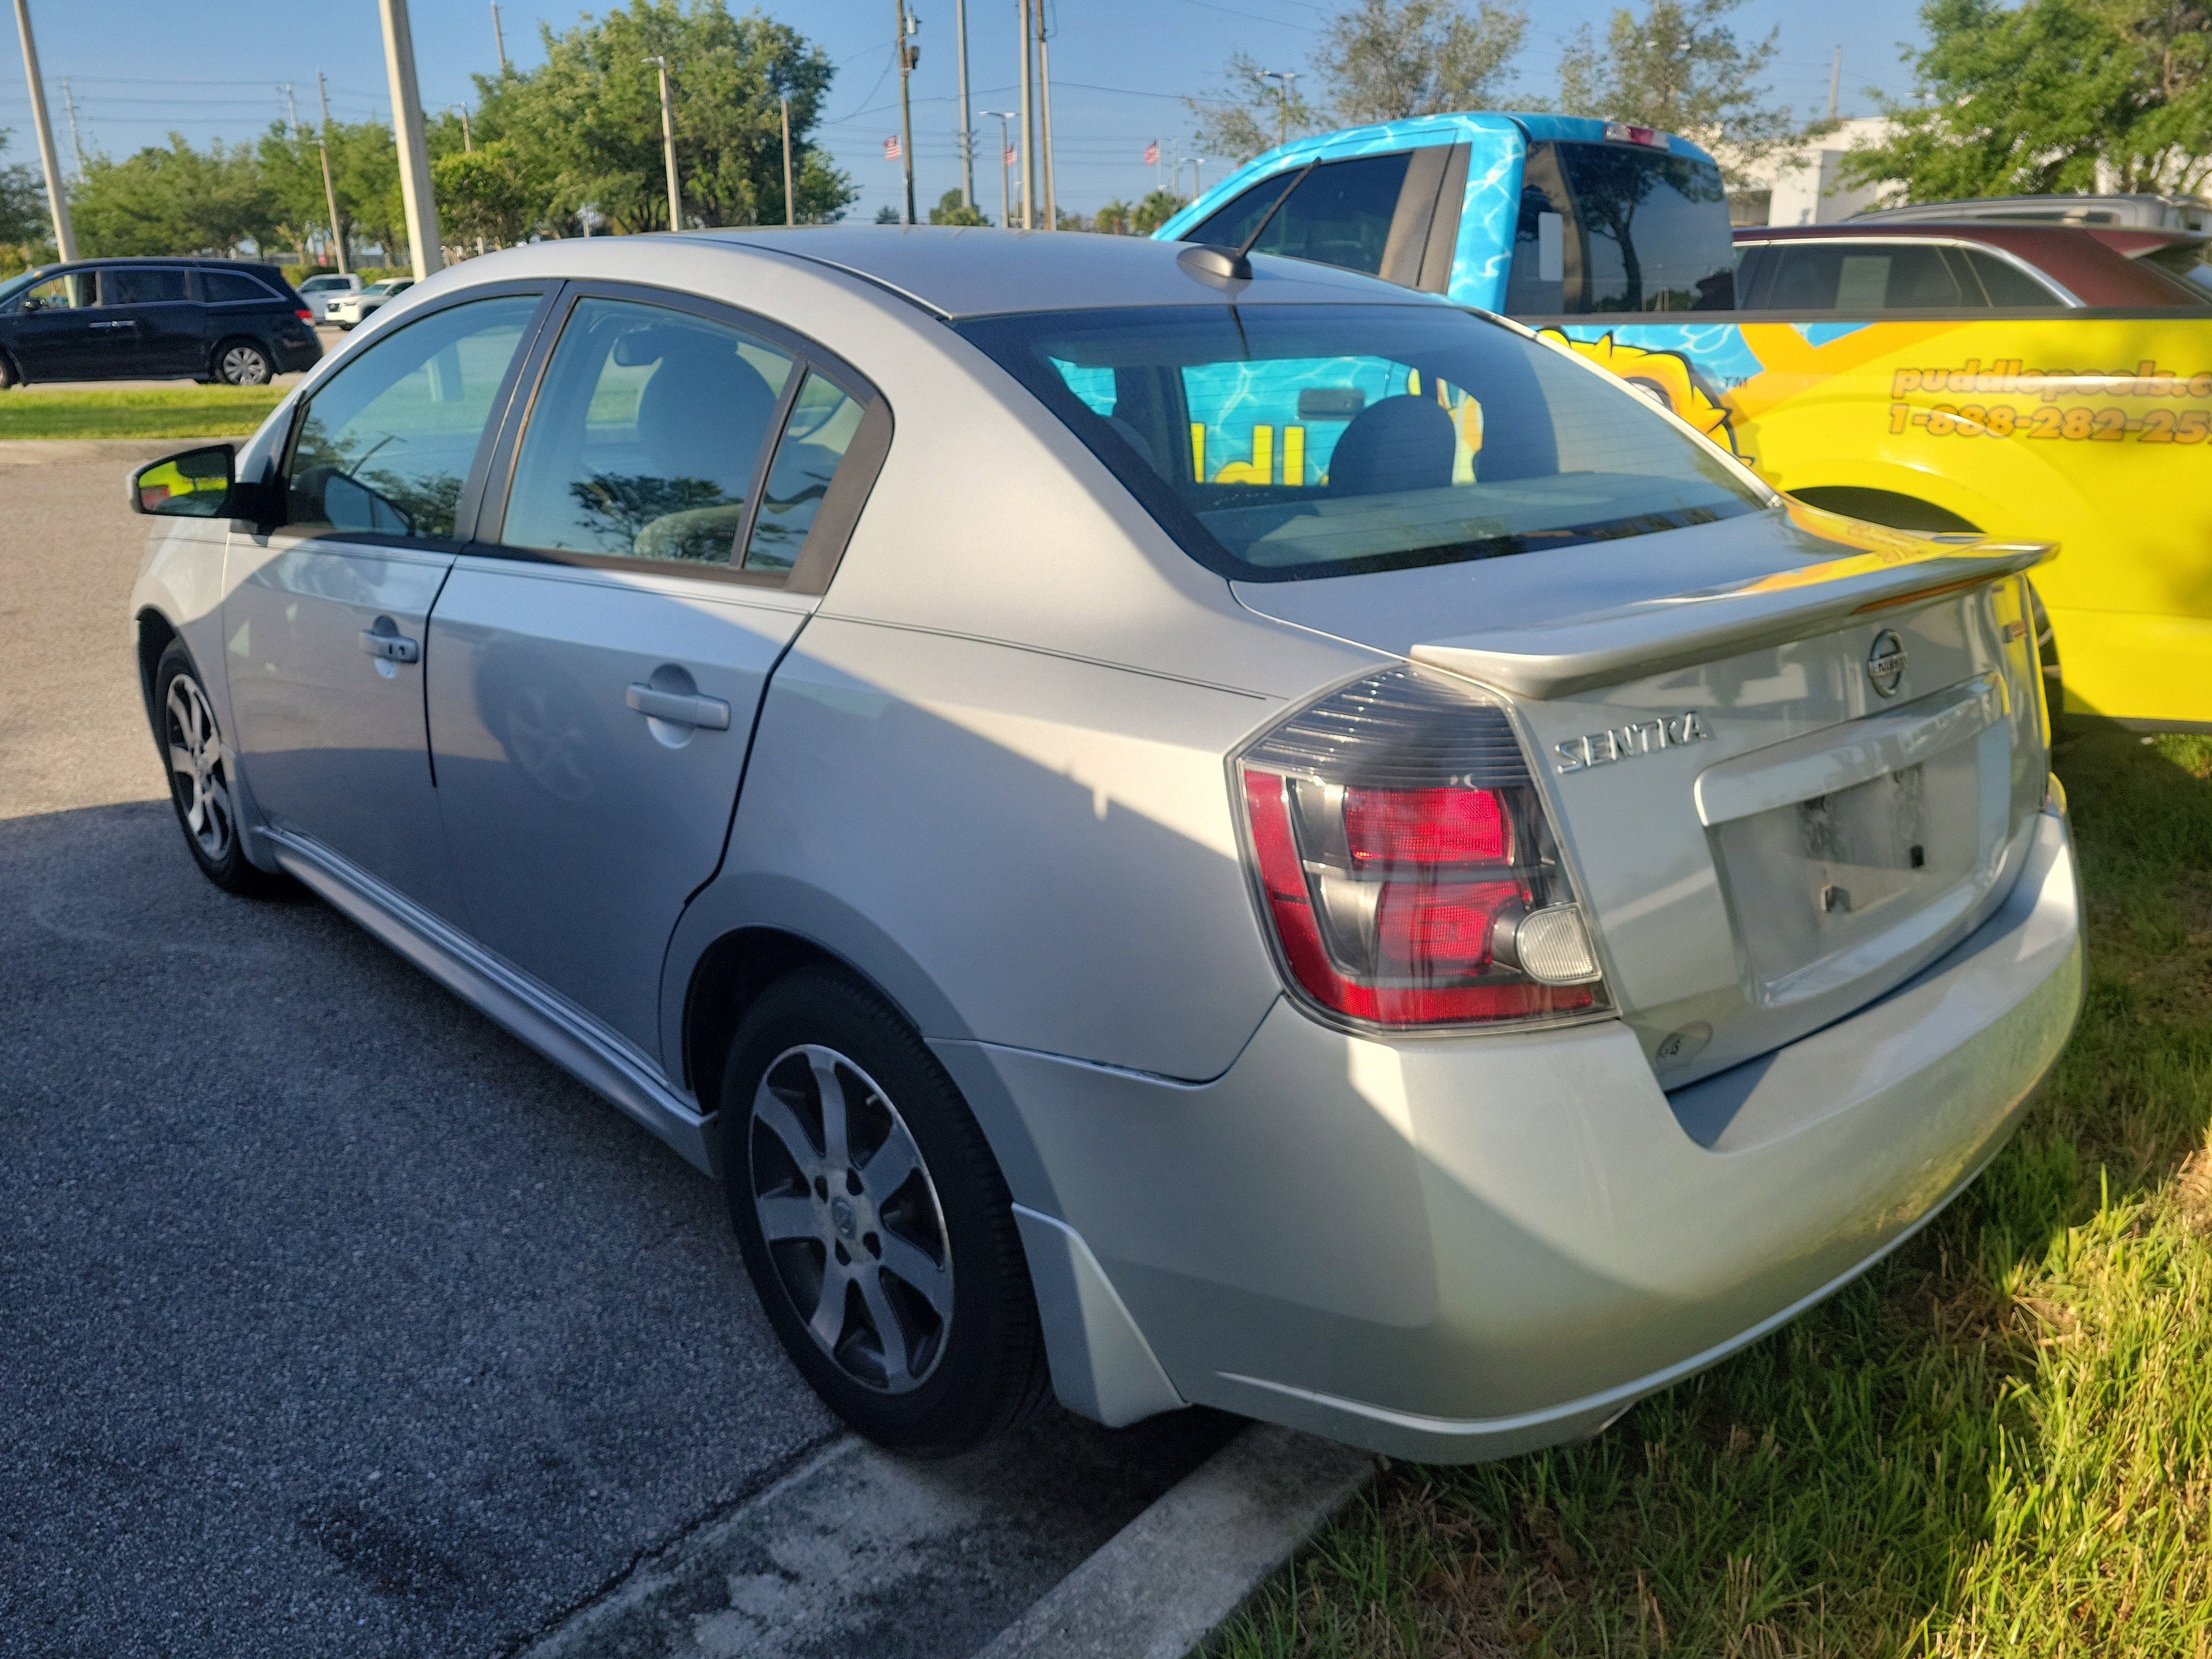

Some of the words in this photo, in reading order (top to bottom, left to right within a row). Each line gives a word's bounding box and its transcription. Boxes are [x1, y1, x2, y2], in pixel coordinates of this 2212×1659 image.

[1891, 358, 2212, 402] puddlepools.c
[1889, 403, 2212, 443] 1-888-282-25
[1554, 711, 1707, 774] SENTRA
